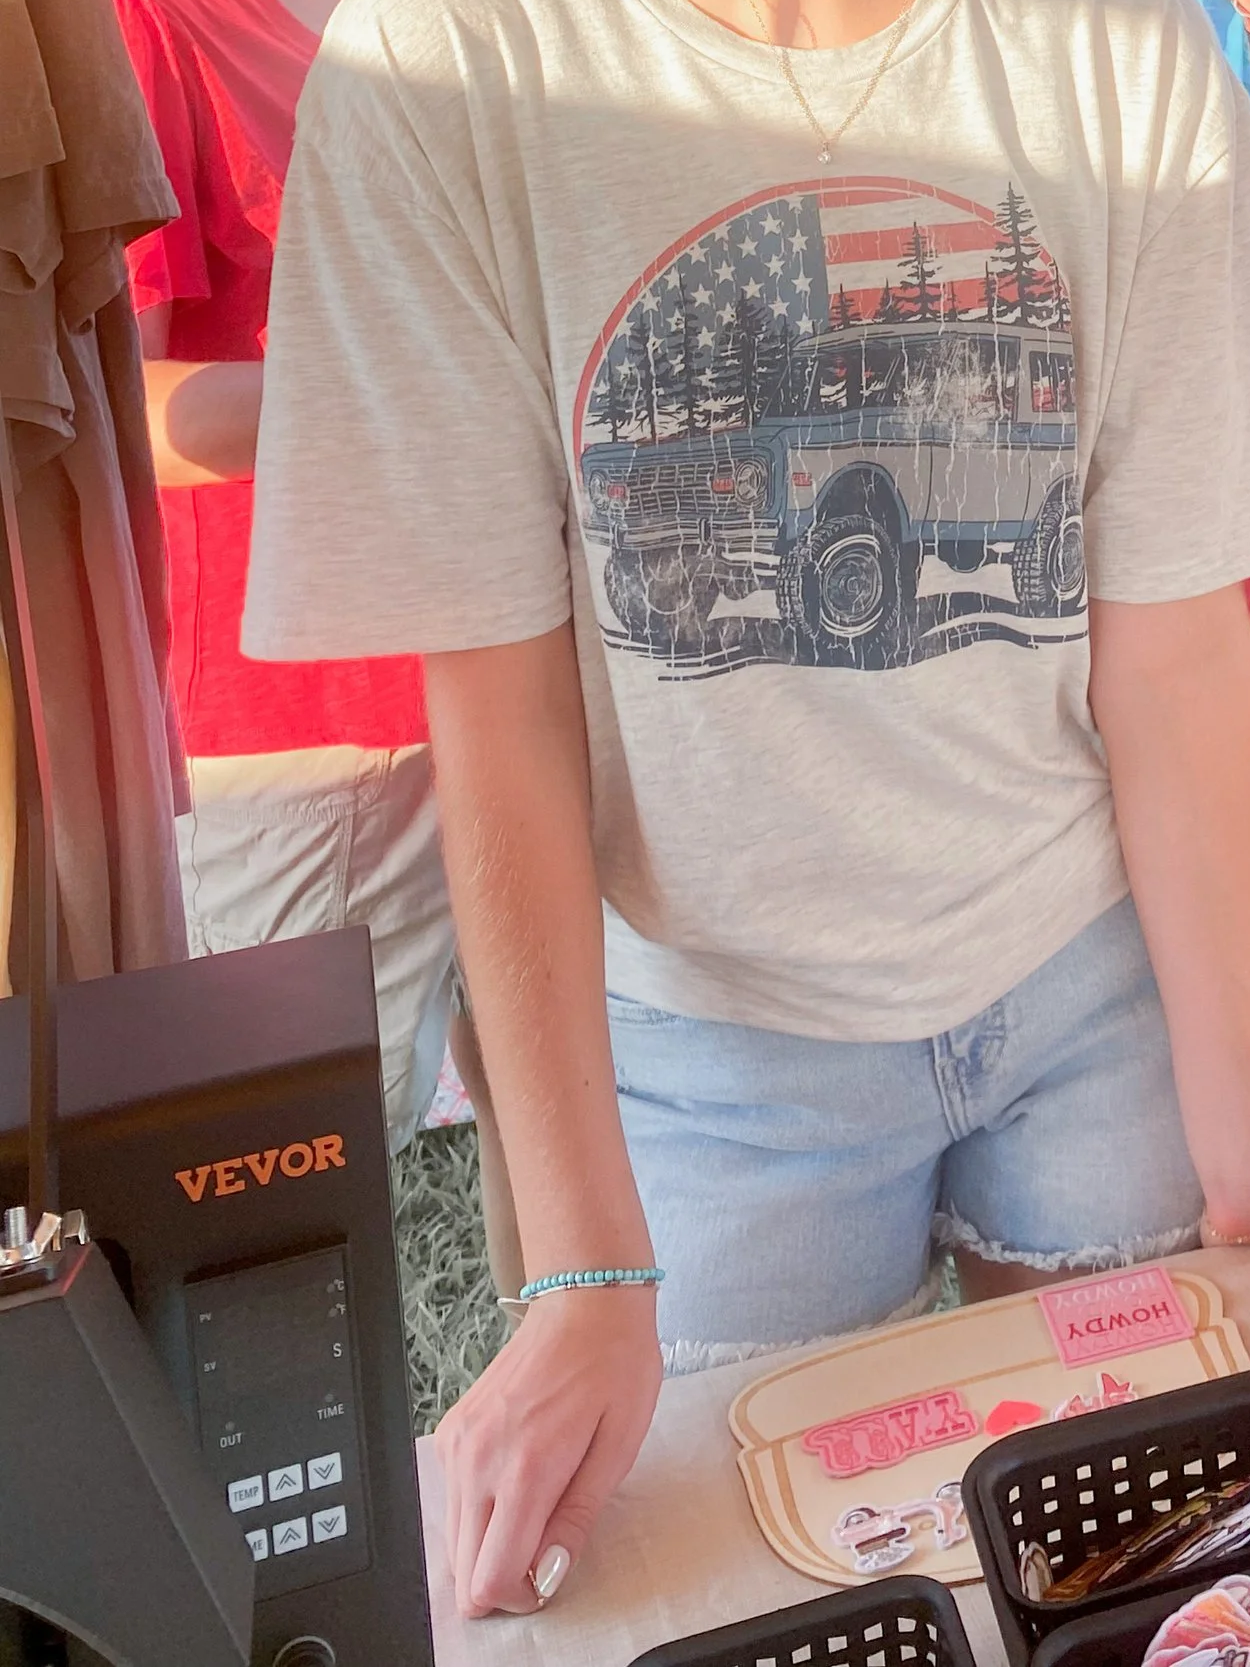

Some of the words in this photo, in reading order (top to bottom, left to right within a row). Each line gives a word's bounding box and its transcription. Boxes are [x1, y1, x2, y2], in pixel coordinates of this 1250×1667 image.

[174, 1134, 347, 1203] VEVOR
[1068, 1301, 1171, 1340] HOWDY
[332, 1343, 342, 1358] S
[316, 1403, 345, 1421] TIME
[219, 1432, 243, 1448] OUT
[232, 1485, 260, 1503] TEMP
